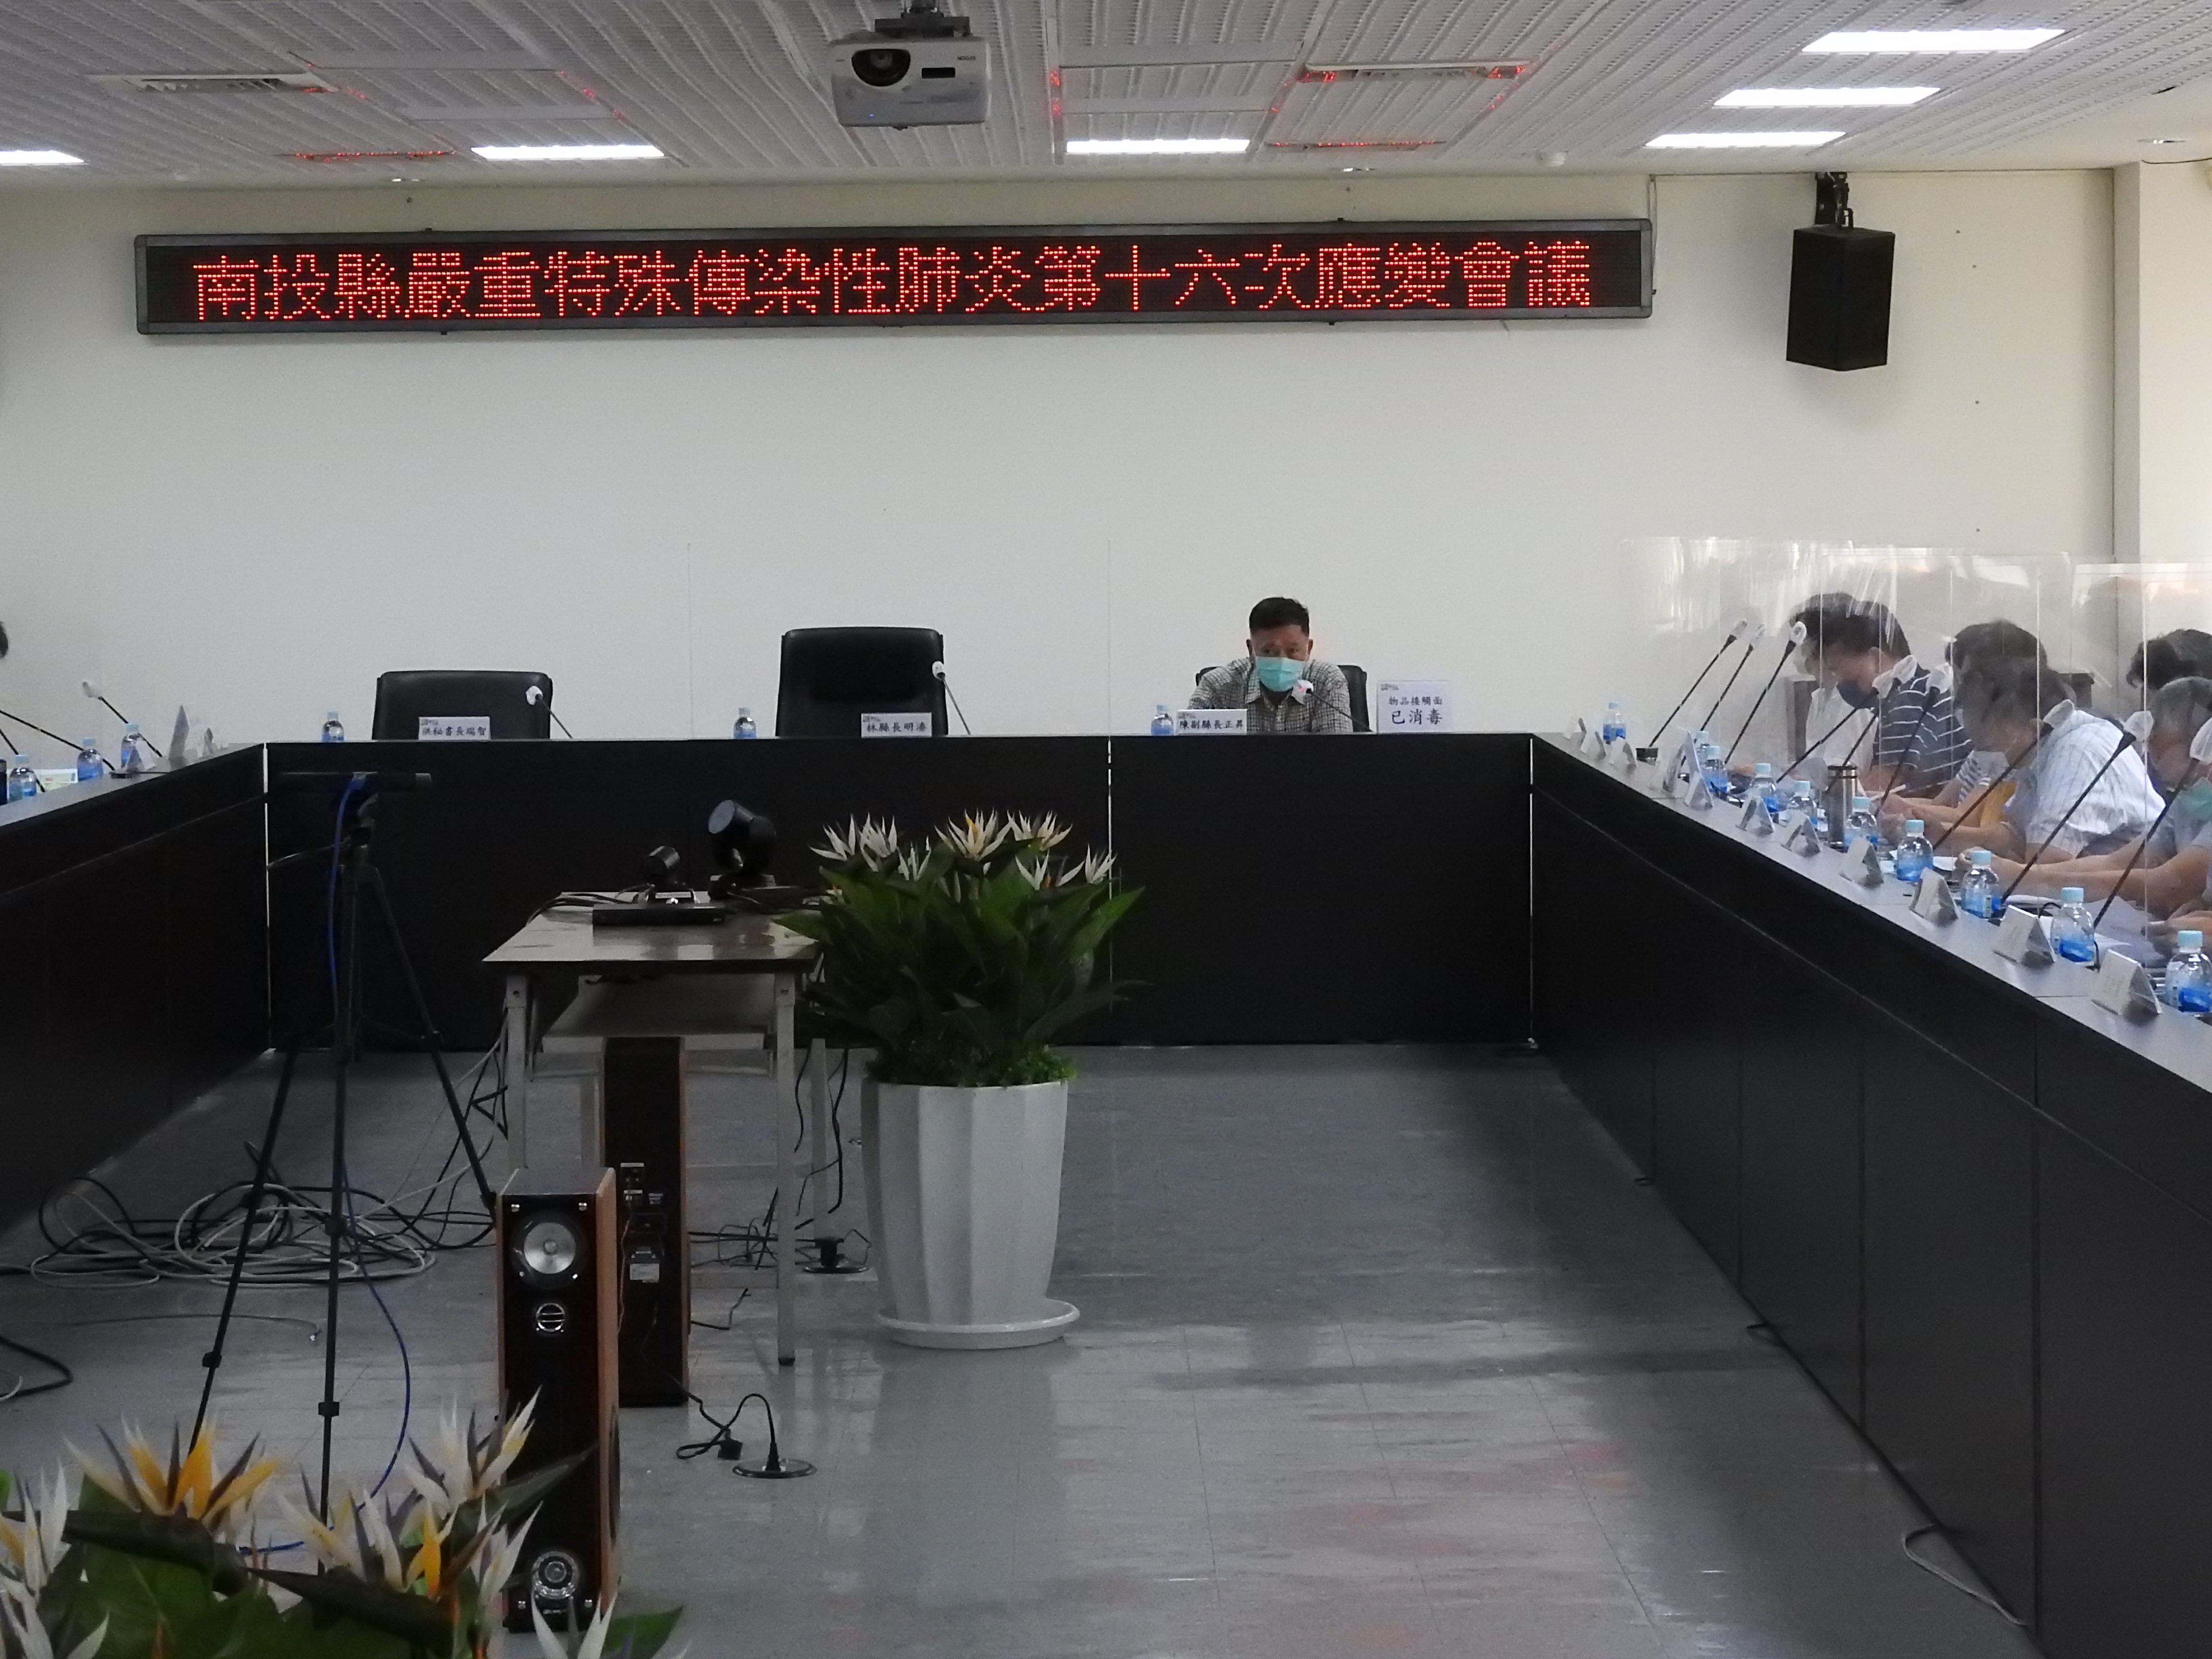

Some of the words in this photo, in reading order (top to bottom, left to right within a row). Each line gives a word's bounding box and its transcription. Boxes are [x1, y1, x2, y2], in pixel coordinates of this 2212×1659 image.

[192, 240, 1591, 321] 南投縣嚴重特殊傳染性肺炎第十六次應變會議
[1392, 708, 1443, 725] 已消毒
